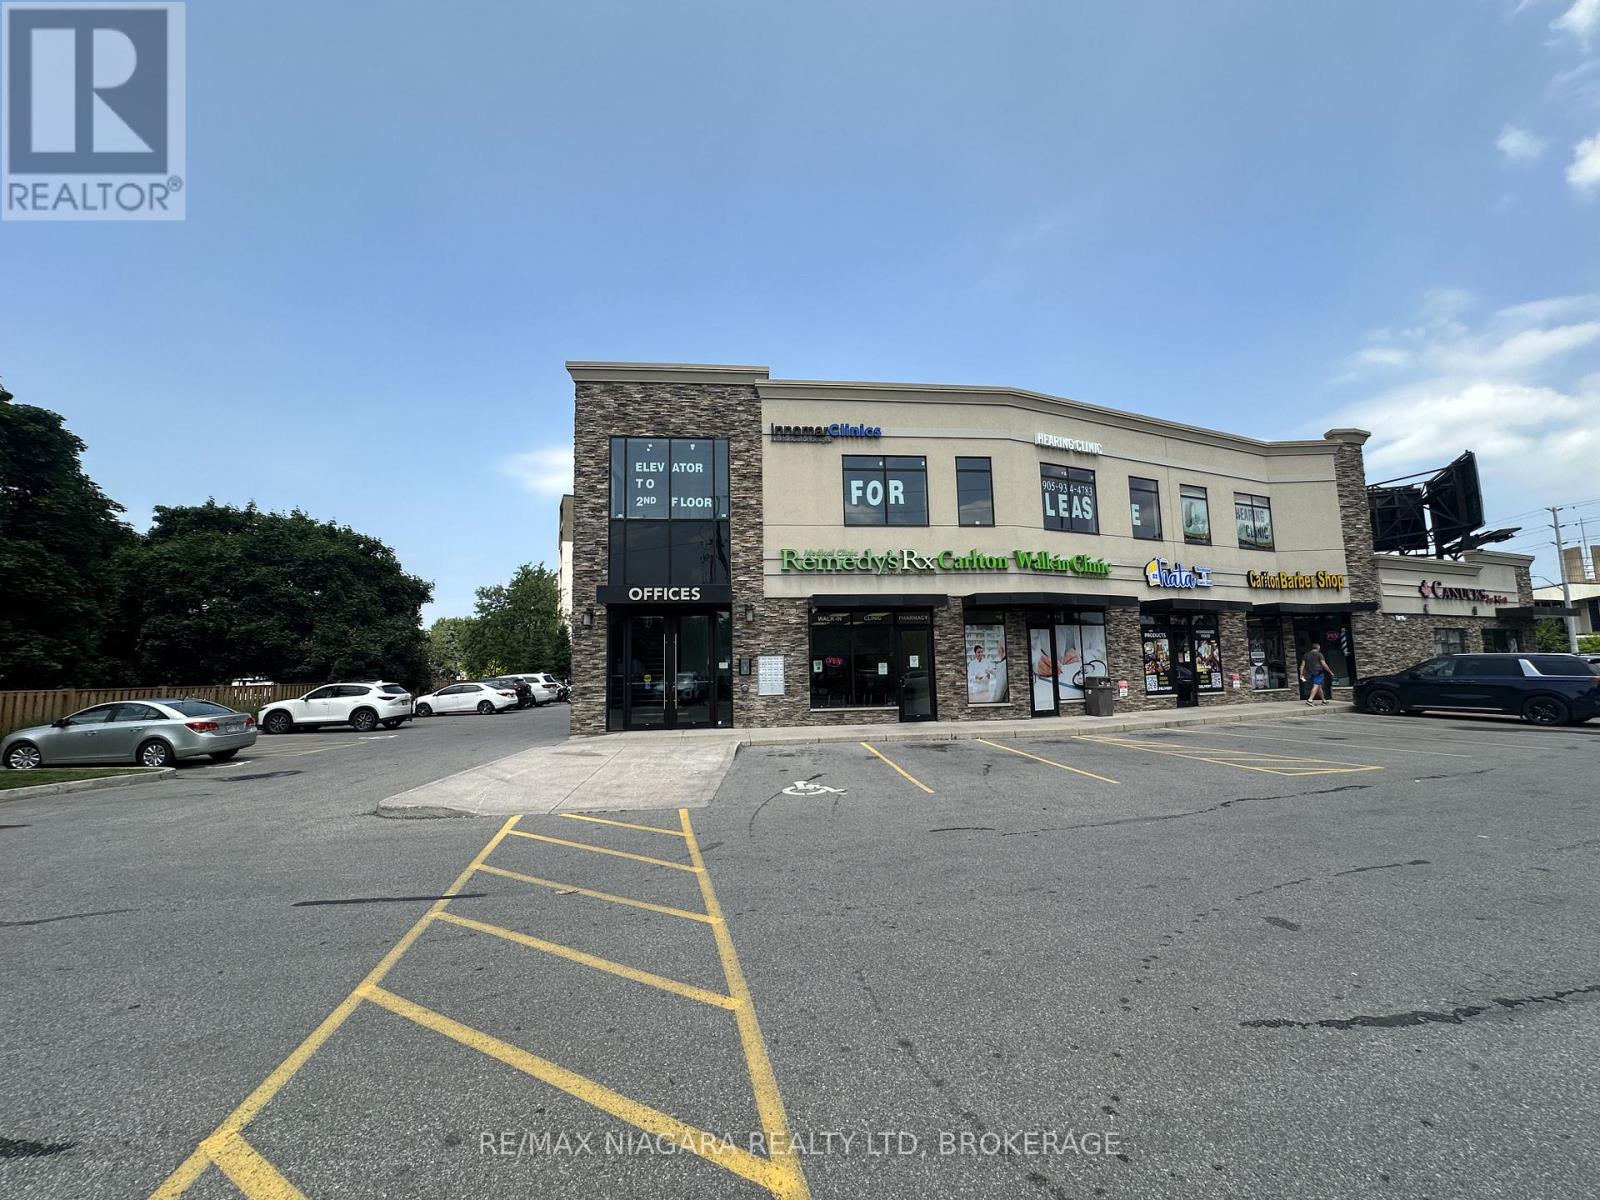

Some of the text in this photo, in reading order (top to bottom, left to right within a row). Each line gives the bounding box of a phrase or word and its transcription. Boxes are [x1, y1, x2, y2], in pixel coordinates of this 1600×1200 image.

[1035, 432, 1103, 454] HEARING CLINIC
[635, 478, 655, 489] TO
[850, 480, 905, 506] FOR
[636, 496, 712, 508] 2ND FLOOR
[937, 549, 1009, 570] Carlton
[1279, 570, 1315, 589] Barber
[1317, 570, 1345, 591] Shop
[628, 587, 701, 601] OFFICES
